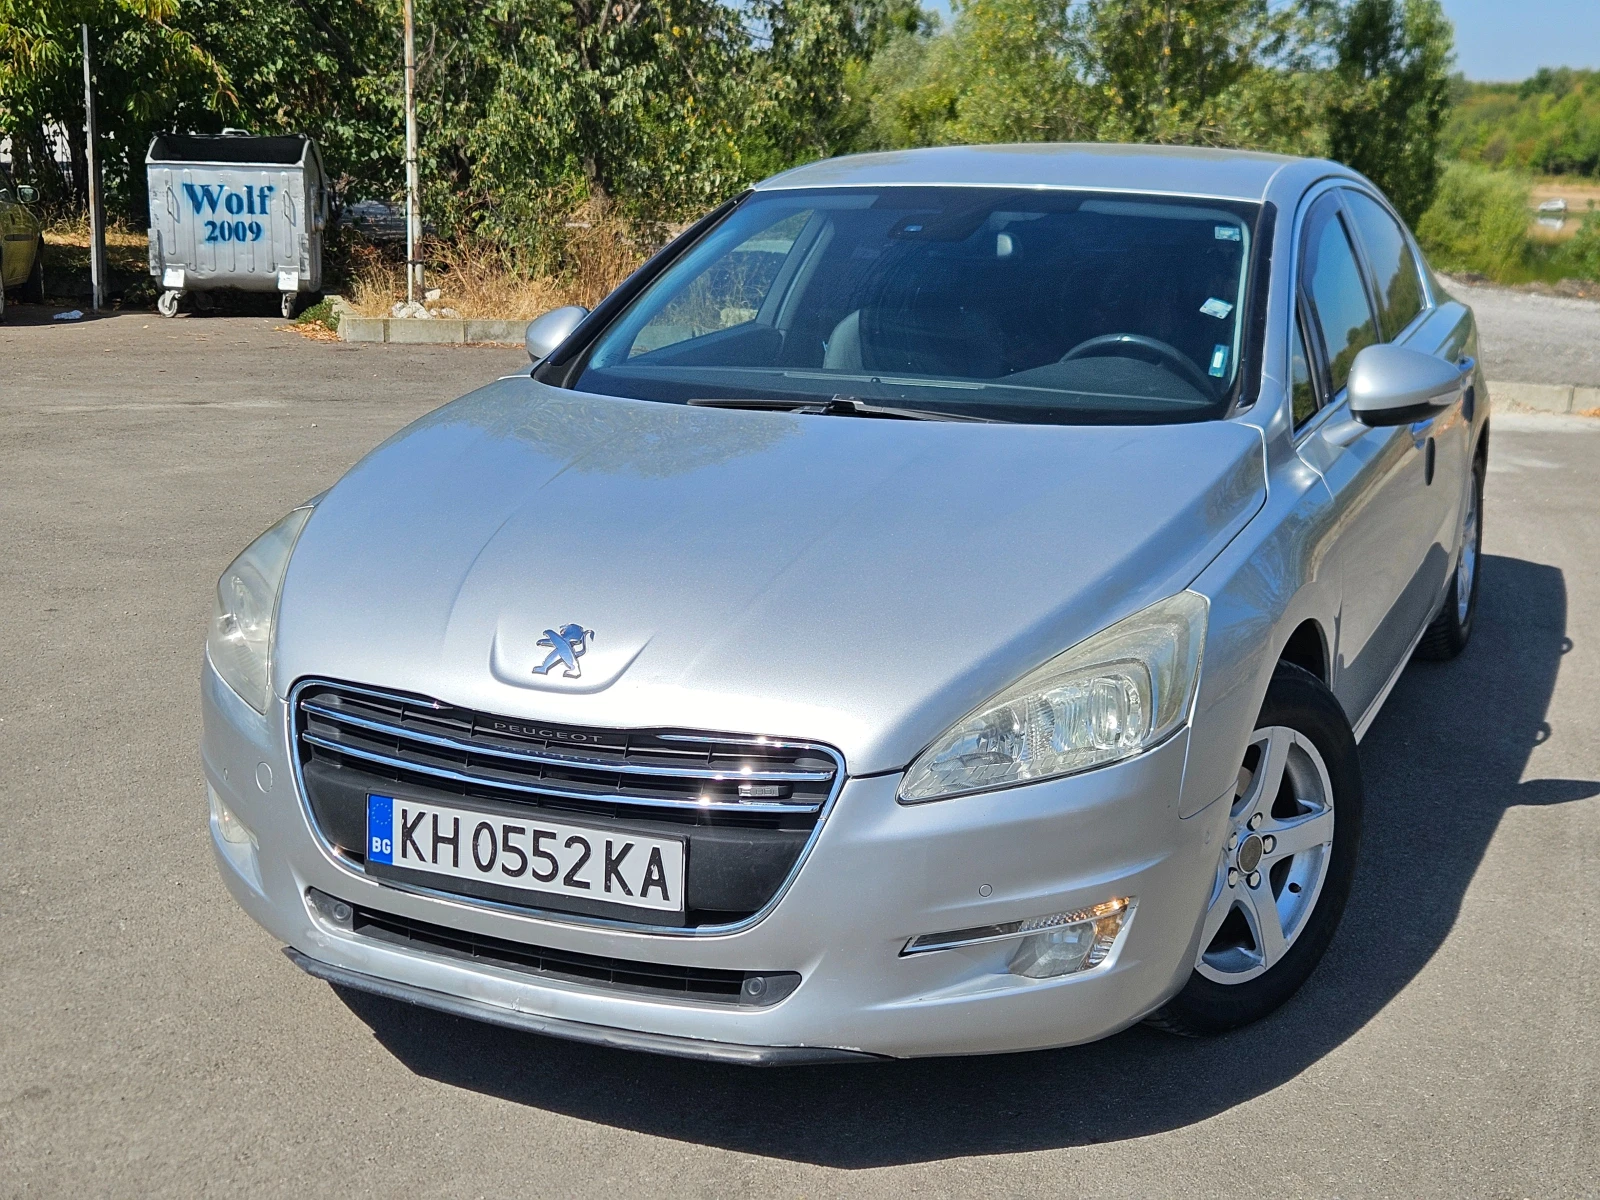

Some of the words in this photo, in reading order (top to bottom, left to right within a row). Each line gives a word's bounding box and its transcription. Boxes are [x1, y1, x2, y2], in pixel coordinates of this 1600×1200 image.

[182, 183, 275, 215] Wolf
[204, 220, 262, 242] 2009
[494, 722, 602, 743] PEUGEOT
[372, 836, 392, 854] BG
